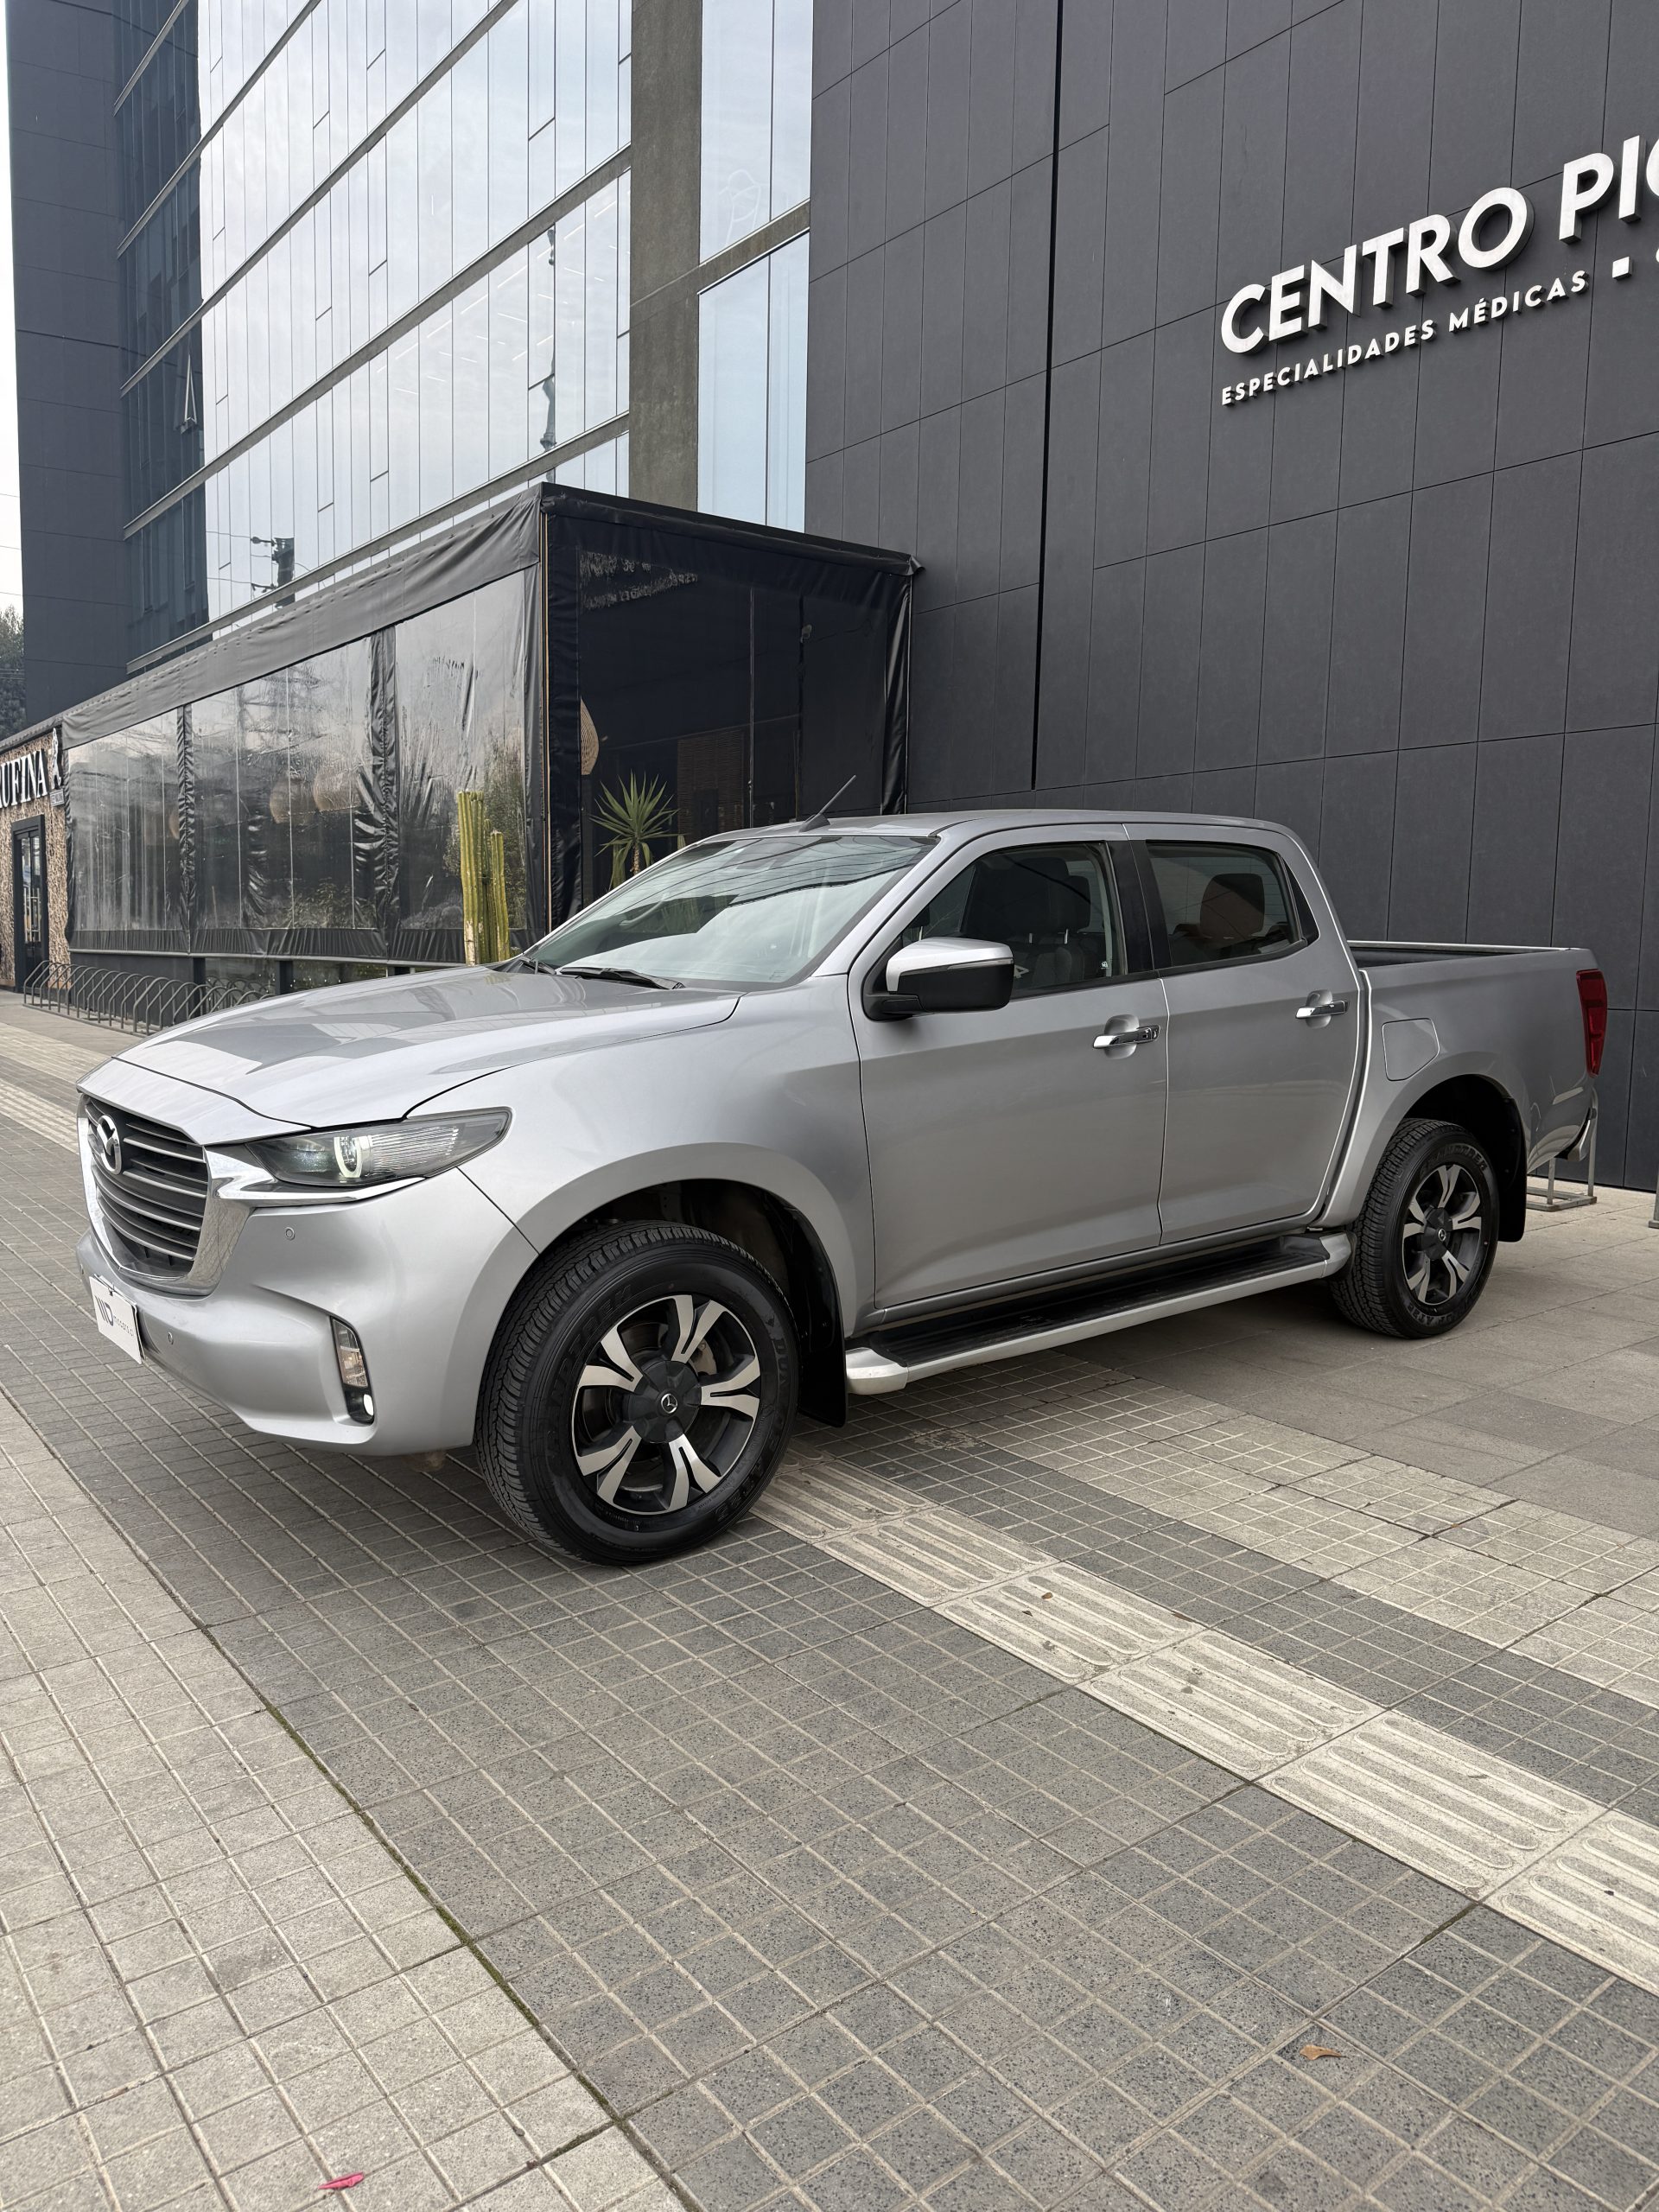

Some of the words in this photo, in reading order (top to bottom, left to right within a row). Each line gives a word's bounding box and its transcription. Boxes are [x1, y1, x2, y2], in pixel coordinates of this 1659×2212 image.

[1221, 187, 1531, 356] CENTRO
[1222, 320, 1436, 407] ESPECIALIDADES
[1449, 270, 1589, 334] MÉDICAS
[0, 749, 48, 809] UFINA
